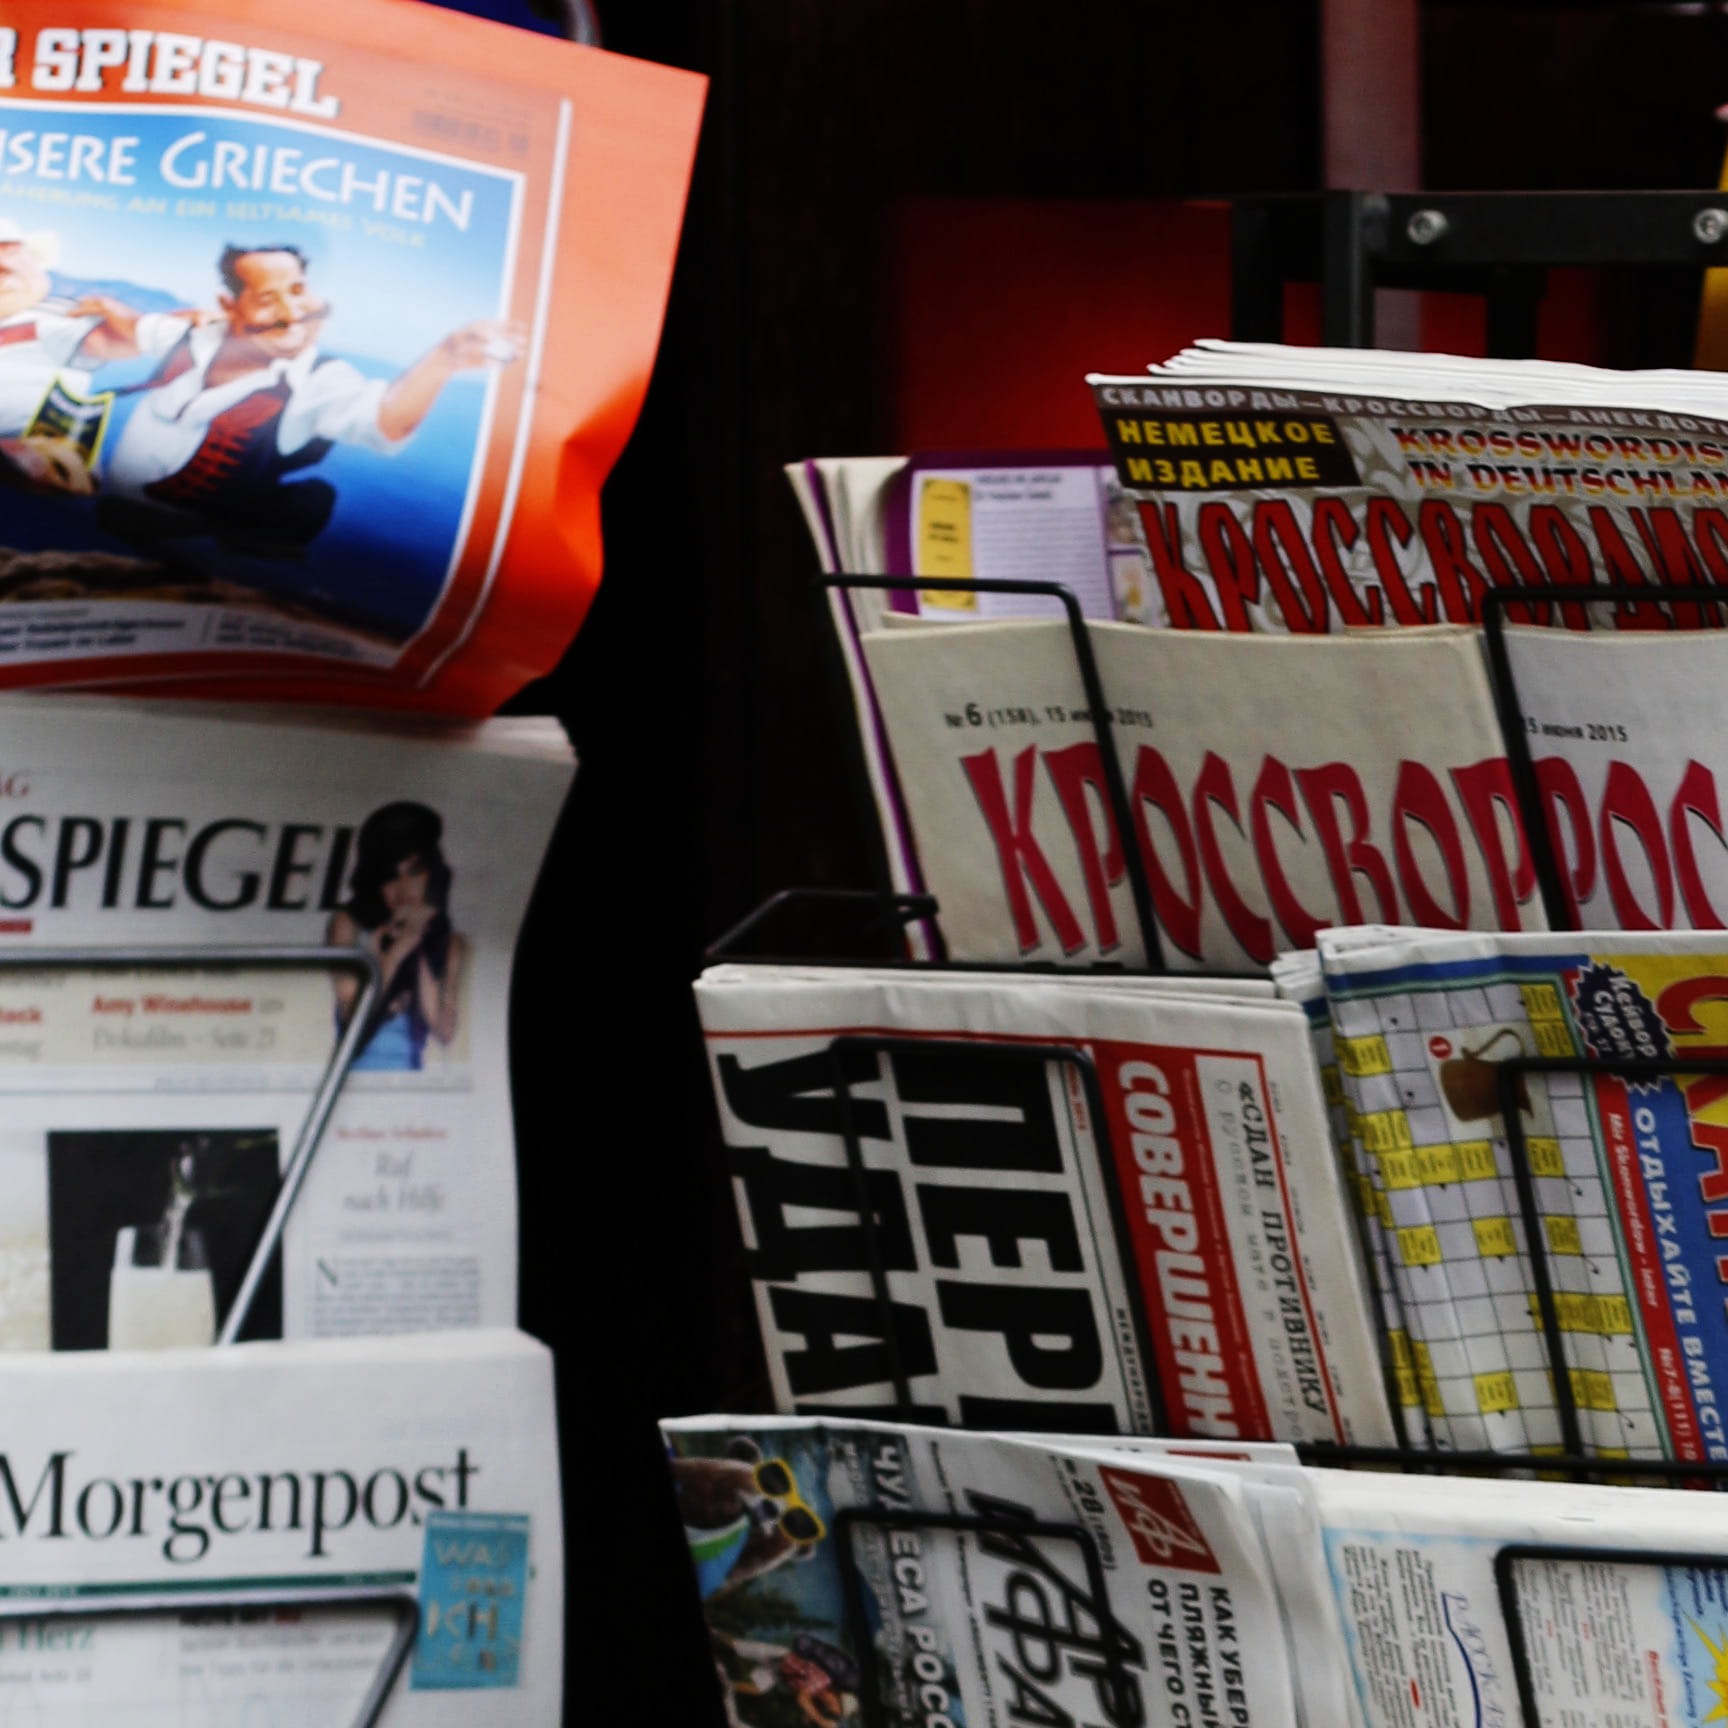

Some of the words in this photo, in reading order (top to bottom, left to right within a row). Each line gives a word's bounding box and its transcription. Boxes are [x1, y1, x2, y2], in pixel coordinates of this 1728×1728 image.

[32, 27, 340, 118] SPIEGEL
[160, 131, 474, 232] GRIECHEN
[1116, 418, 1336, 450] НЕМЕЦКОЕ
[1127, 455, 1321, 488] ИЗДАНИЕ
[1407, 459, 1455, 487] IN
[1587, 719, 1629, 744] 2015
[1634, 1106, 1696, 1326] ОТДЫХАЙТЕ
[1262, 1210, 1328, 1415] ПРОТИВНИКУ
[0, 1448, 481, 1565] Morgenpost
[1146, 1577, 1172, 1617] ОТ
[1207, 1586, 1239, 1642] КАК
[1154, 1622, 1188, 1695] ЧЕГО
